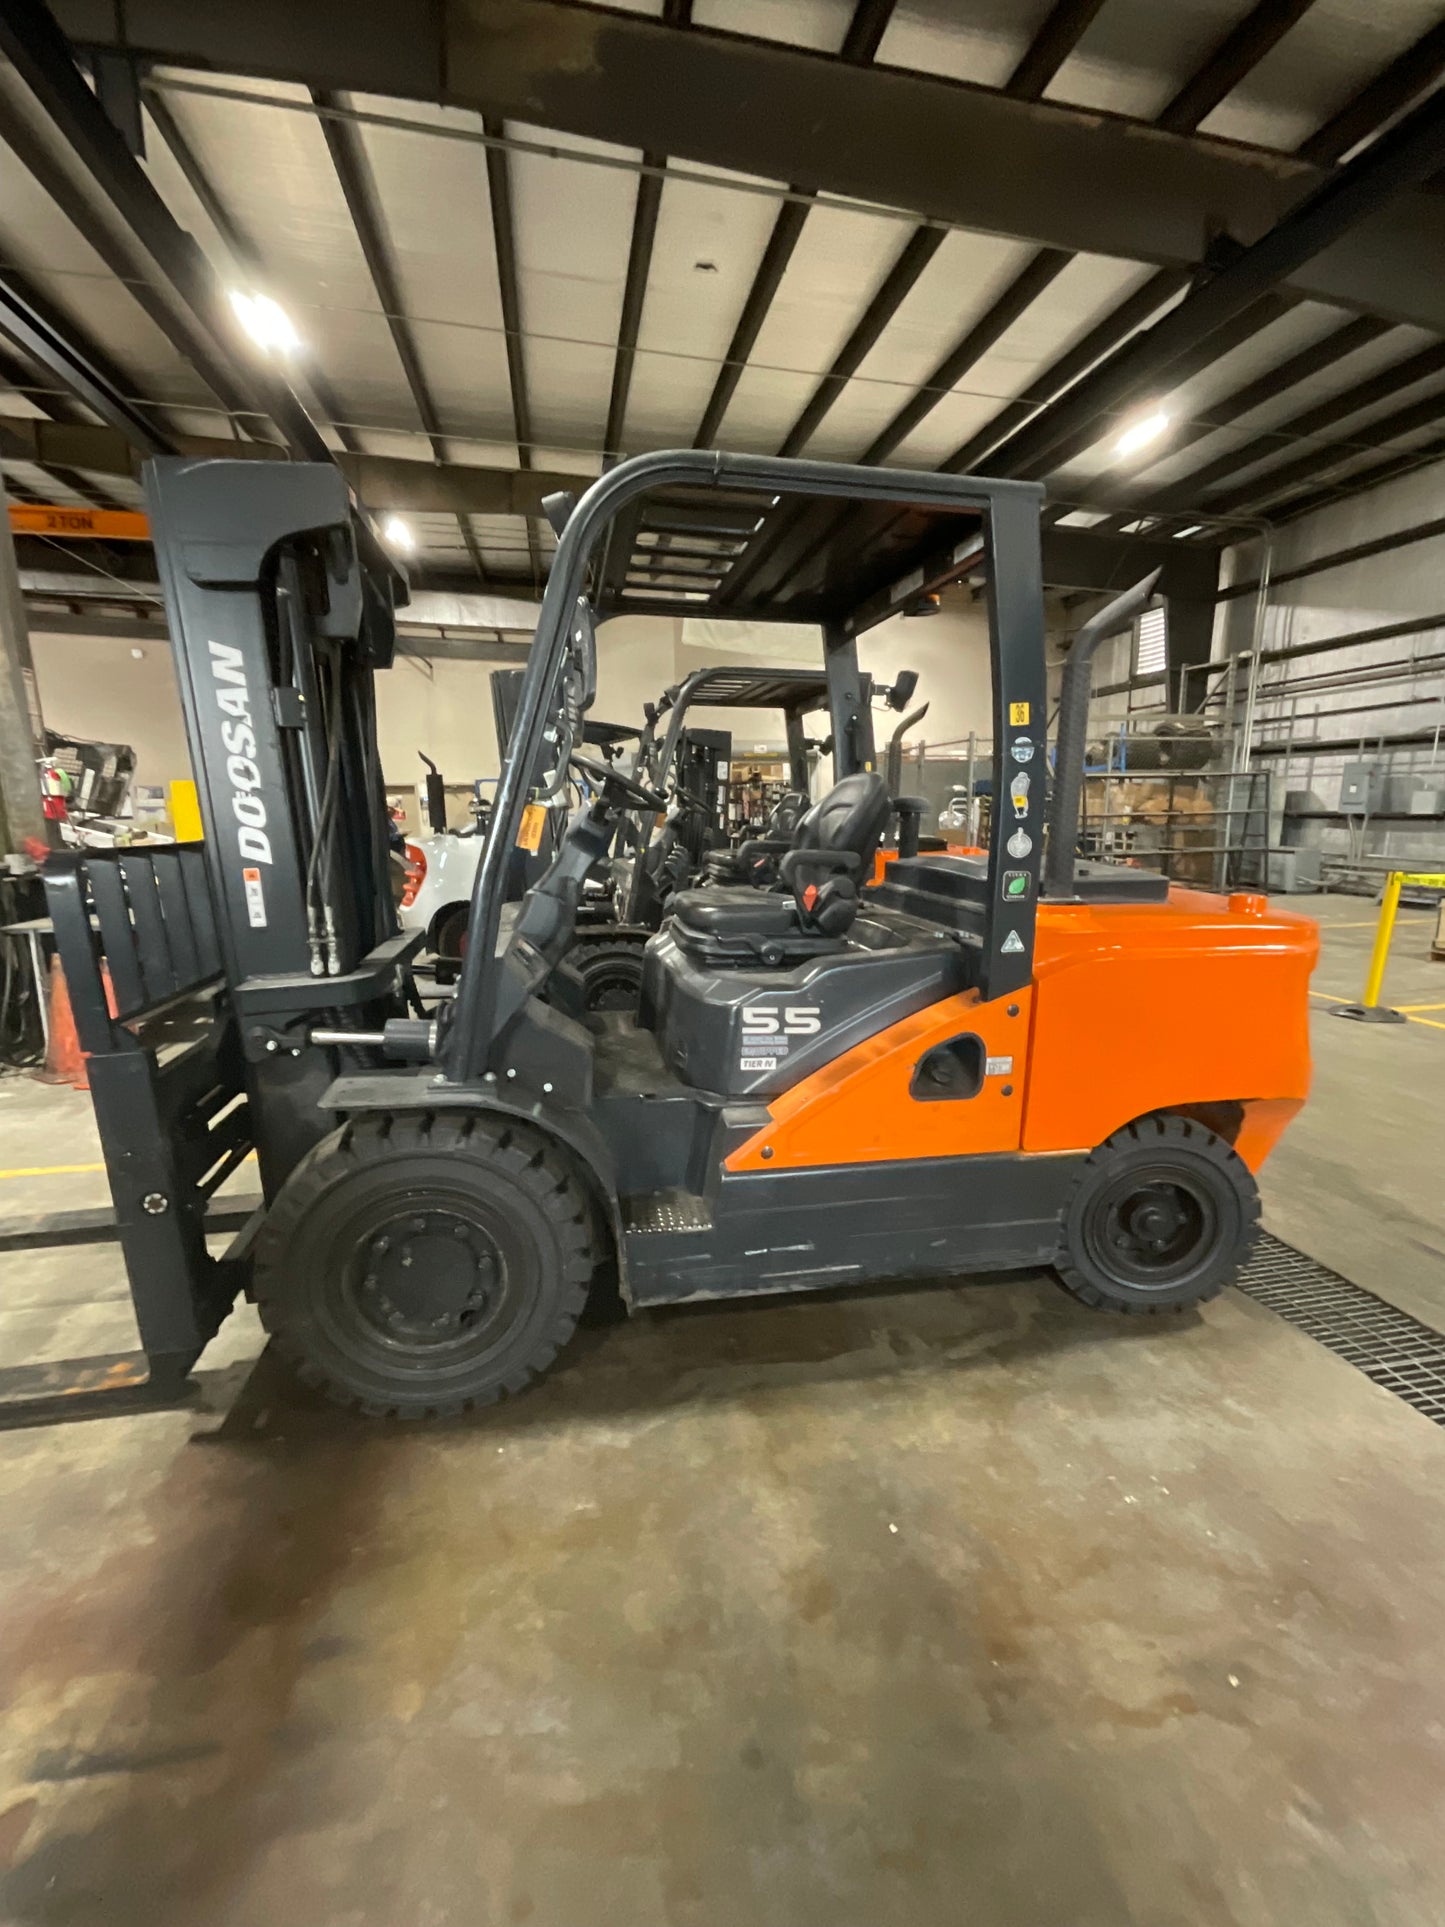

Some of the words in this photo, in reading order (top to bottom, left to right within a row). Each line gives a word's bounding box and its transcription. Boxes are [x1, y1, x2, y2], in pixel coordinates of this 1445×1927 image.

[47, 515, 57, 528] 2
[59, 516, 94, 530] TON
[208, 640, 273, 865] DOOSAN
[743, 1060, 763, 1068] TIER
[764, 1060, 774, 1068] IV
